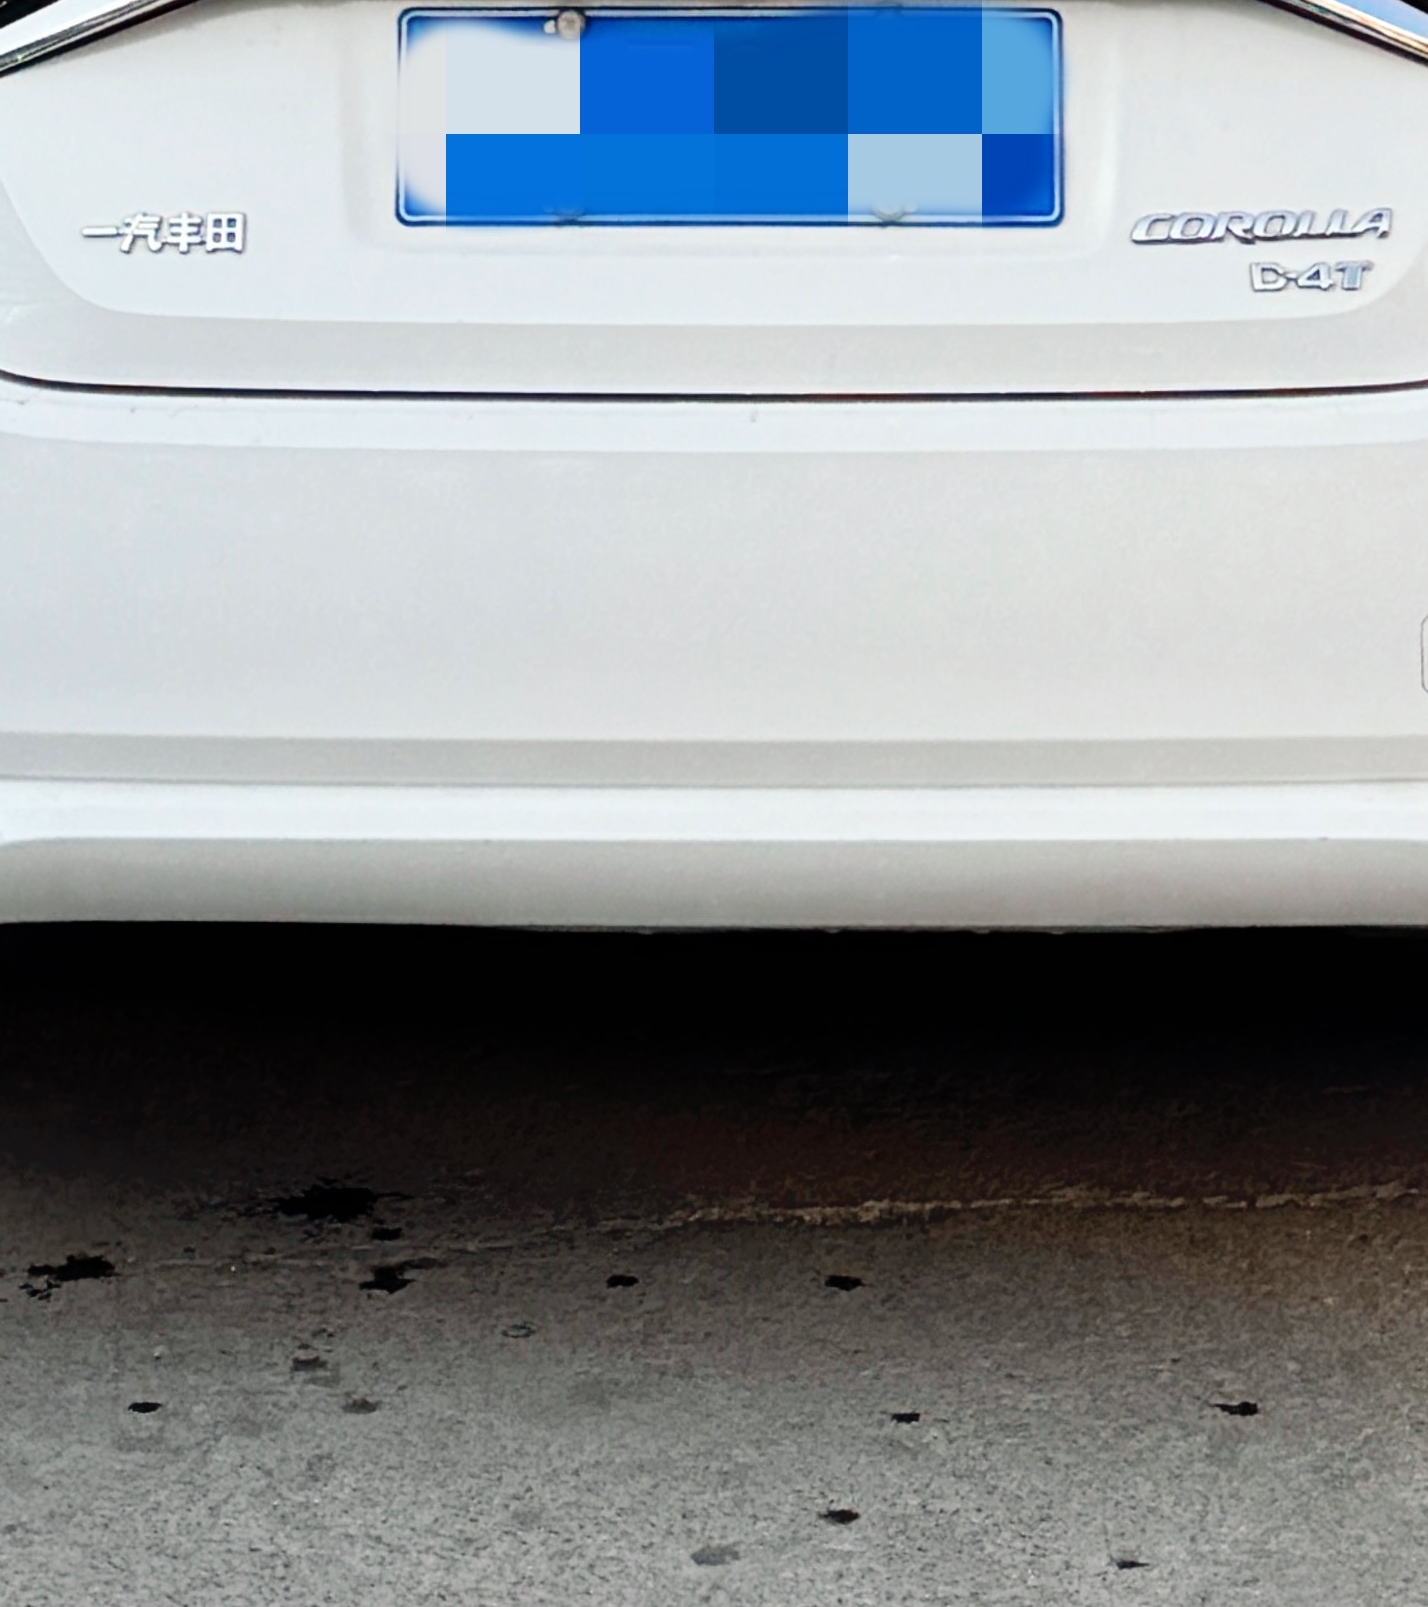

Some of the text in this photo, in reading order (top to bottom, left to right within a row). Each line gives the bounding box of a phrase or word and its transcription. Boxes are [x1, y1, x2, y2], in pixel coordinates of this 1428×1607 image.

[81, 212, 247, 255] 一汽丰田
[1130, 207, 1393, 245] COROLLA
[1250, 260, 1374, 293] D-4T
